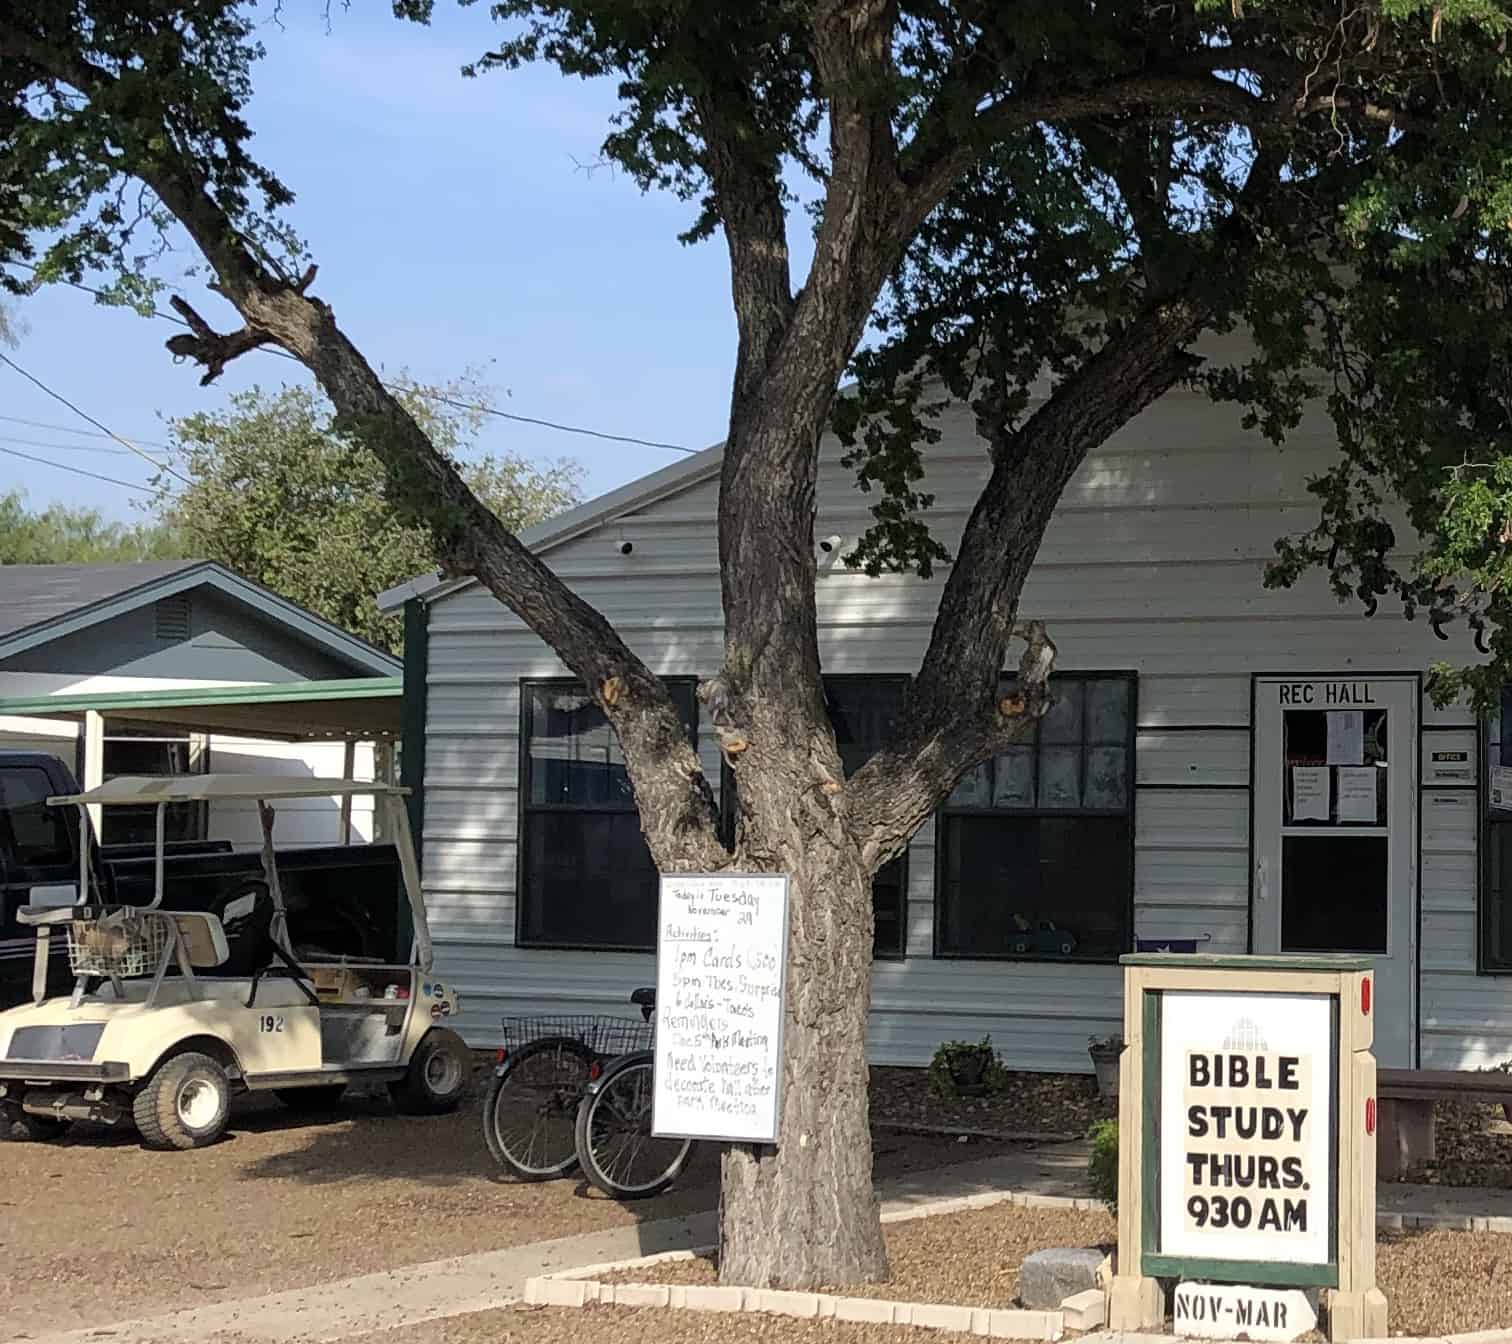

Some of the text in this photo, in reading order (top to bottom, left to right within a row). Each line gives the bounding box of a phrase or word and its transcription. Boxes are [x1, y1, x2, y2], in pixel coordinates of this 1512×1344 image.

[1280, 683, 1376, 704] REC HALL
[707, 887, 760, 917] Tuesday
[737, 911, 753, 926] 29
[703, 944, 742, 969] Cards
[260, 1016, 284, 1033] 192
[1188, 1053, 1300, 1090] BIBLE
[1187, 1105, 1308, 1143] STUDY
[1186, 1152, 1311, 1191] THURS.
[1187, 1195, 1308, 1233] 930 AM
[1177, 1293, 1288, 1329] NOV-MAR
